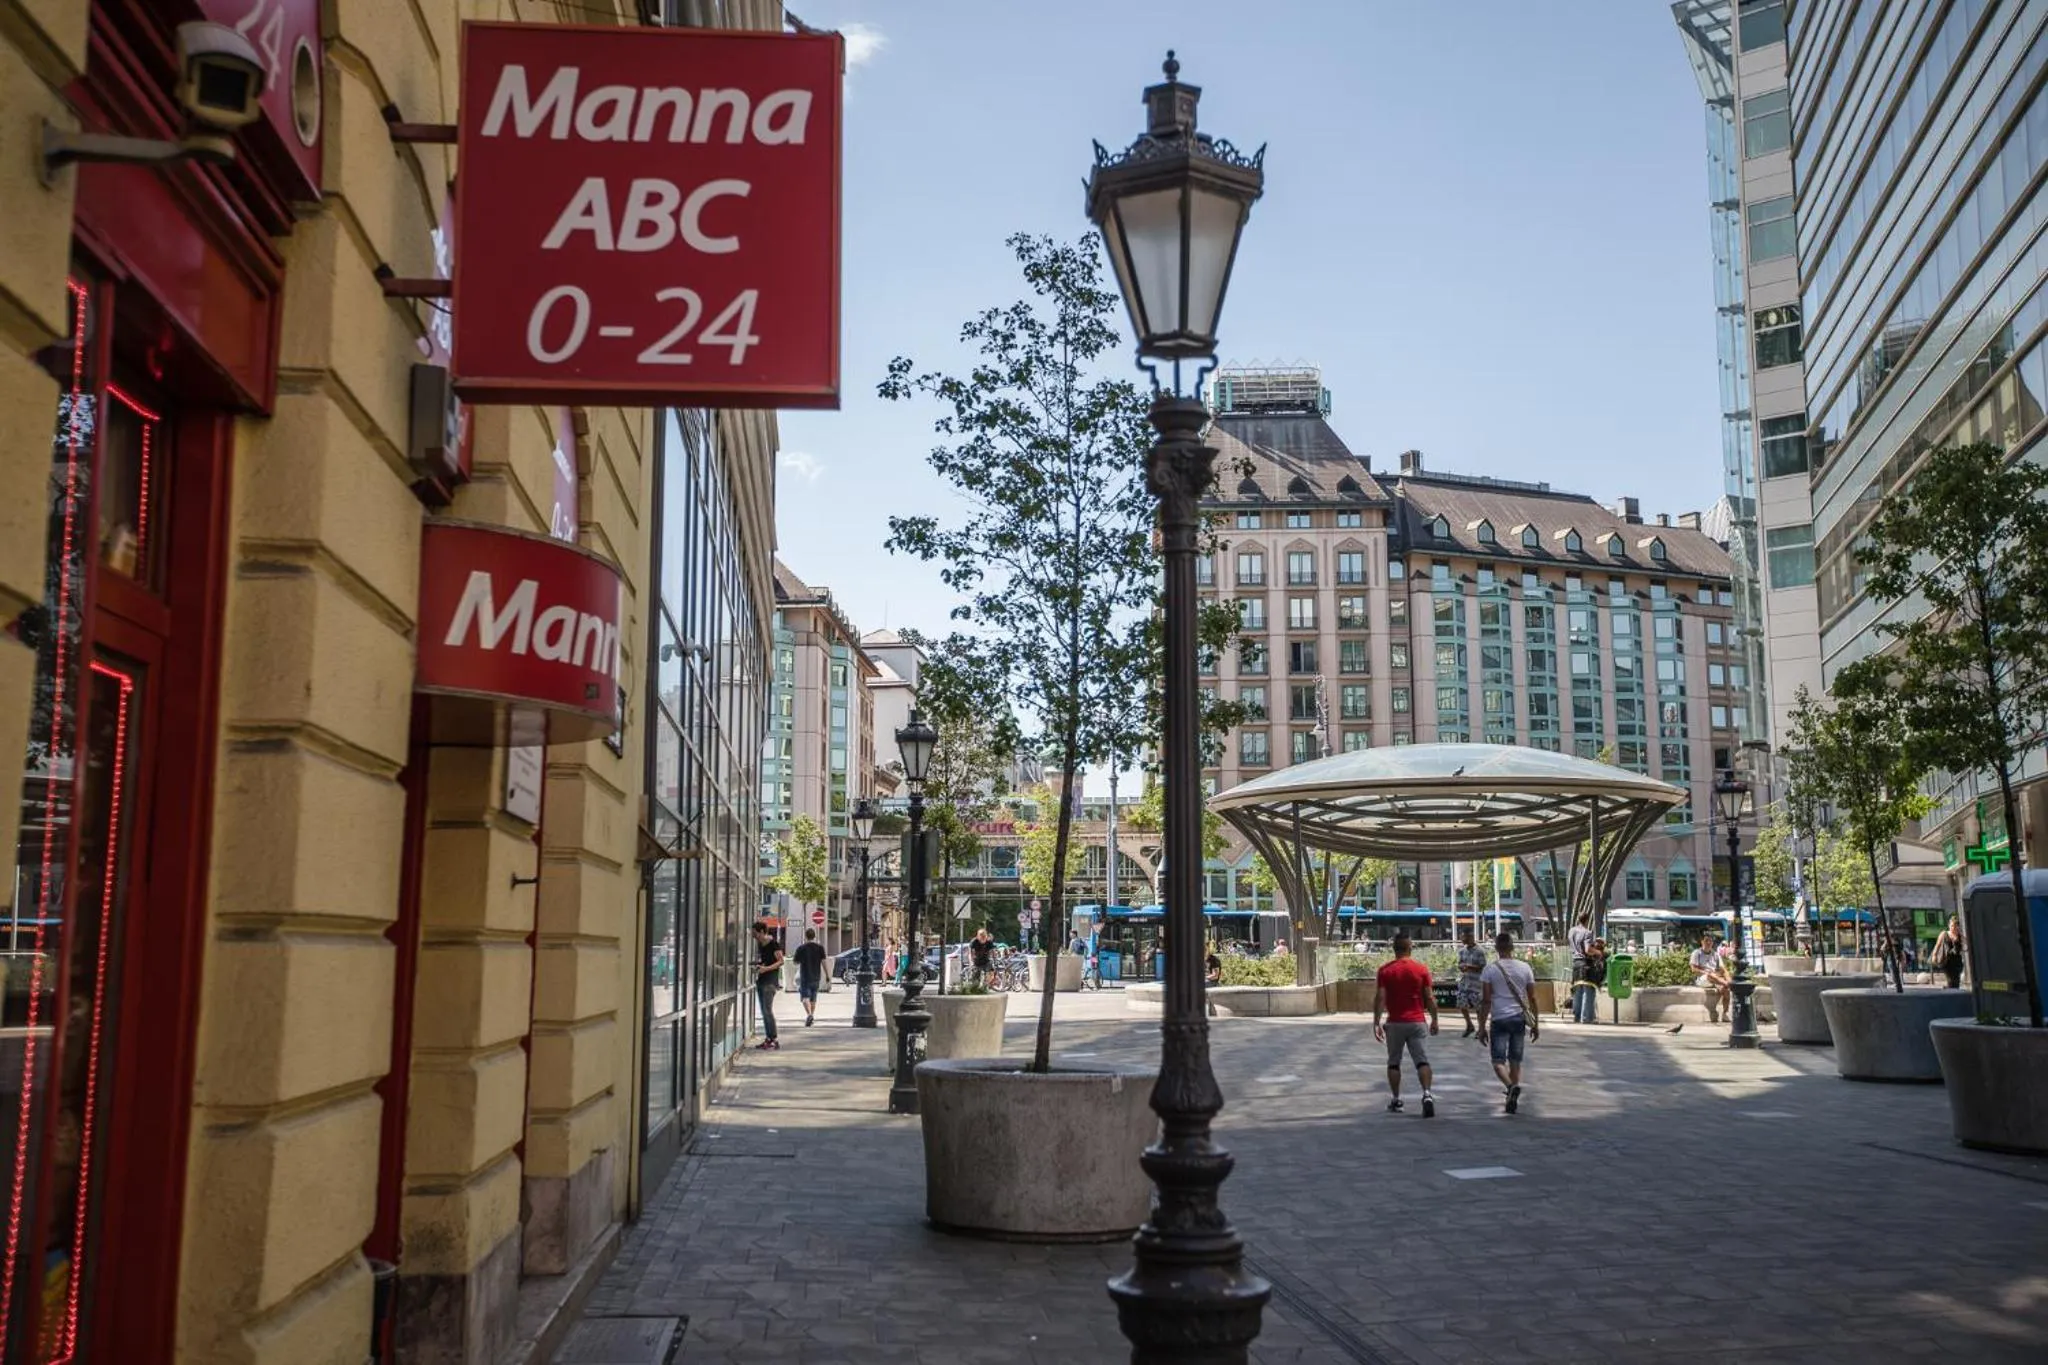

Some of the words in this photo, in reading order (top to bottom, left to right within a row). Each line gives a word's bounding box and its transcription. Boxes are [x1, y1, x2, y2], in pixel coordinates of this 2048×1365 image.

[481, 64, 813, 146] Manna
[541, 176, 752, 254] ABC
[526, 284, 760, 367] 0-24
